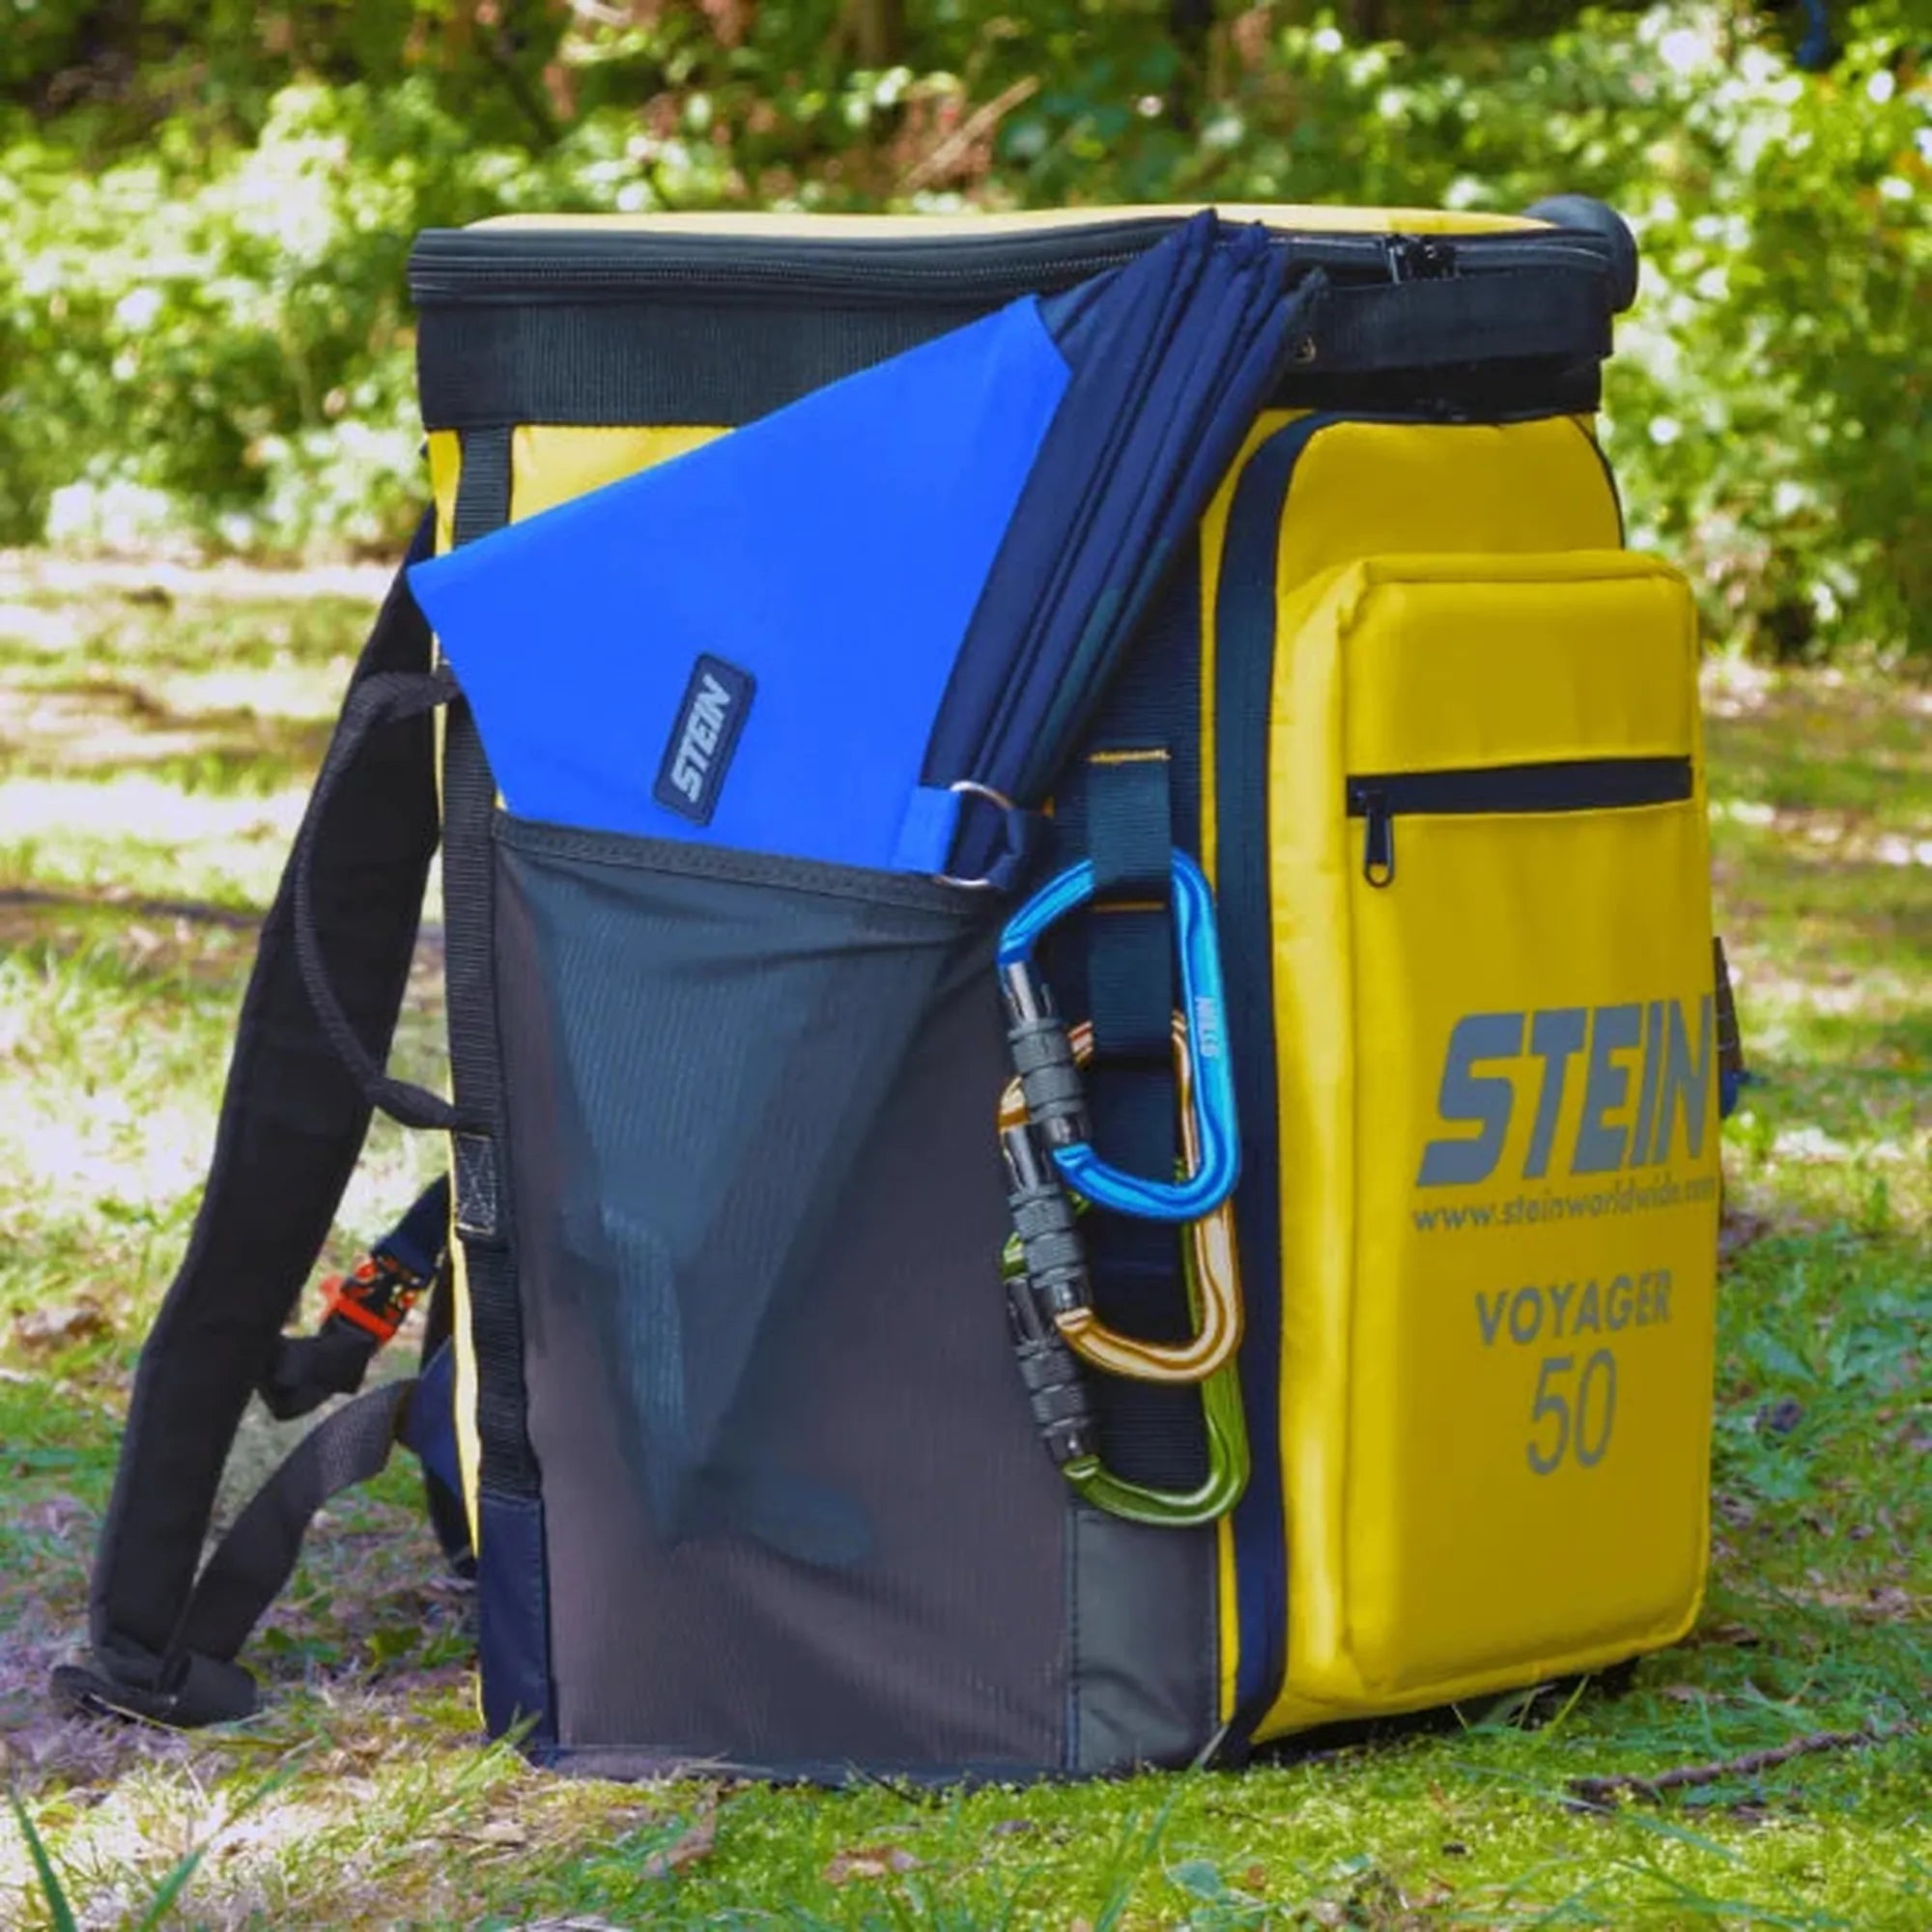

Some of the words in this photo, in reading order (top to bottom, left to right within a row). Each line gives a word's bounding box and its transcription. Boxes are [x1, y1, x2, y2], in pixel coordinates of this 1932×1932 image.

[670, 674, 730, 804] STEIN
[1416, 994, 1713, 1187] STEIN
[1474, 1268, 1671, 1347] VOYAGER
[1526, 1349, 1617, 1476] 50
